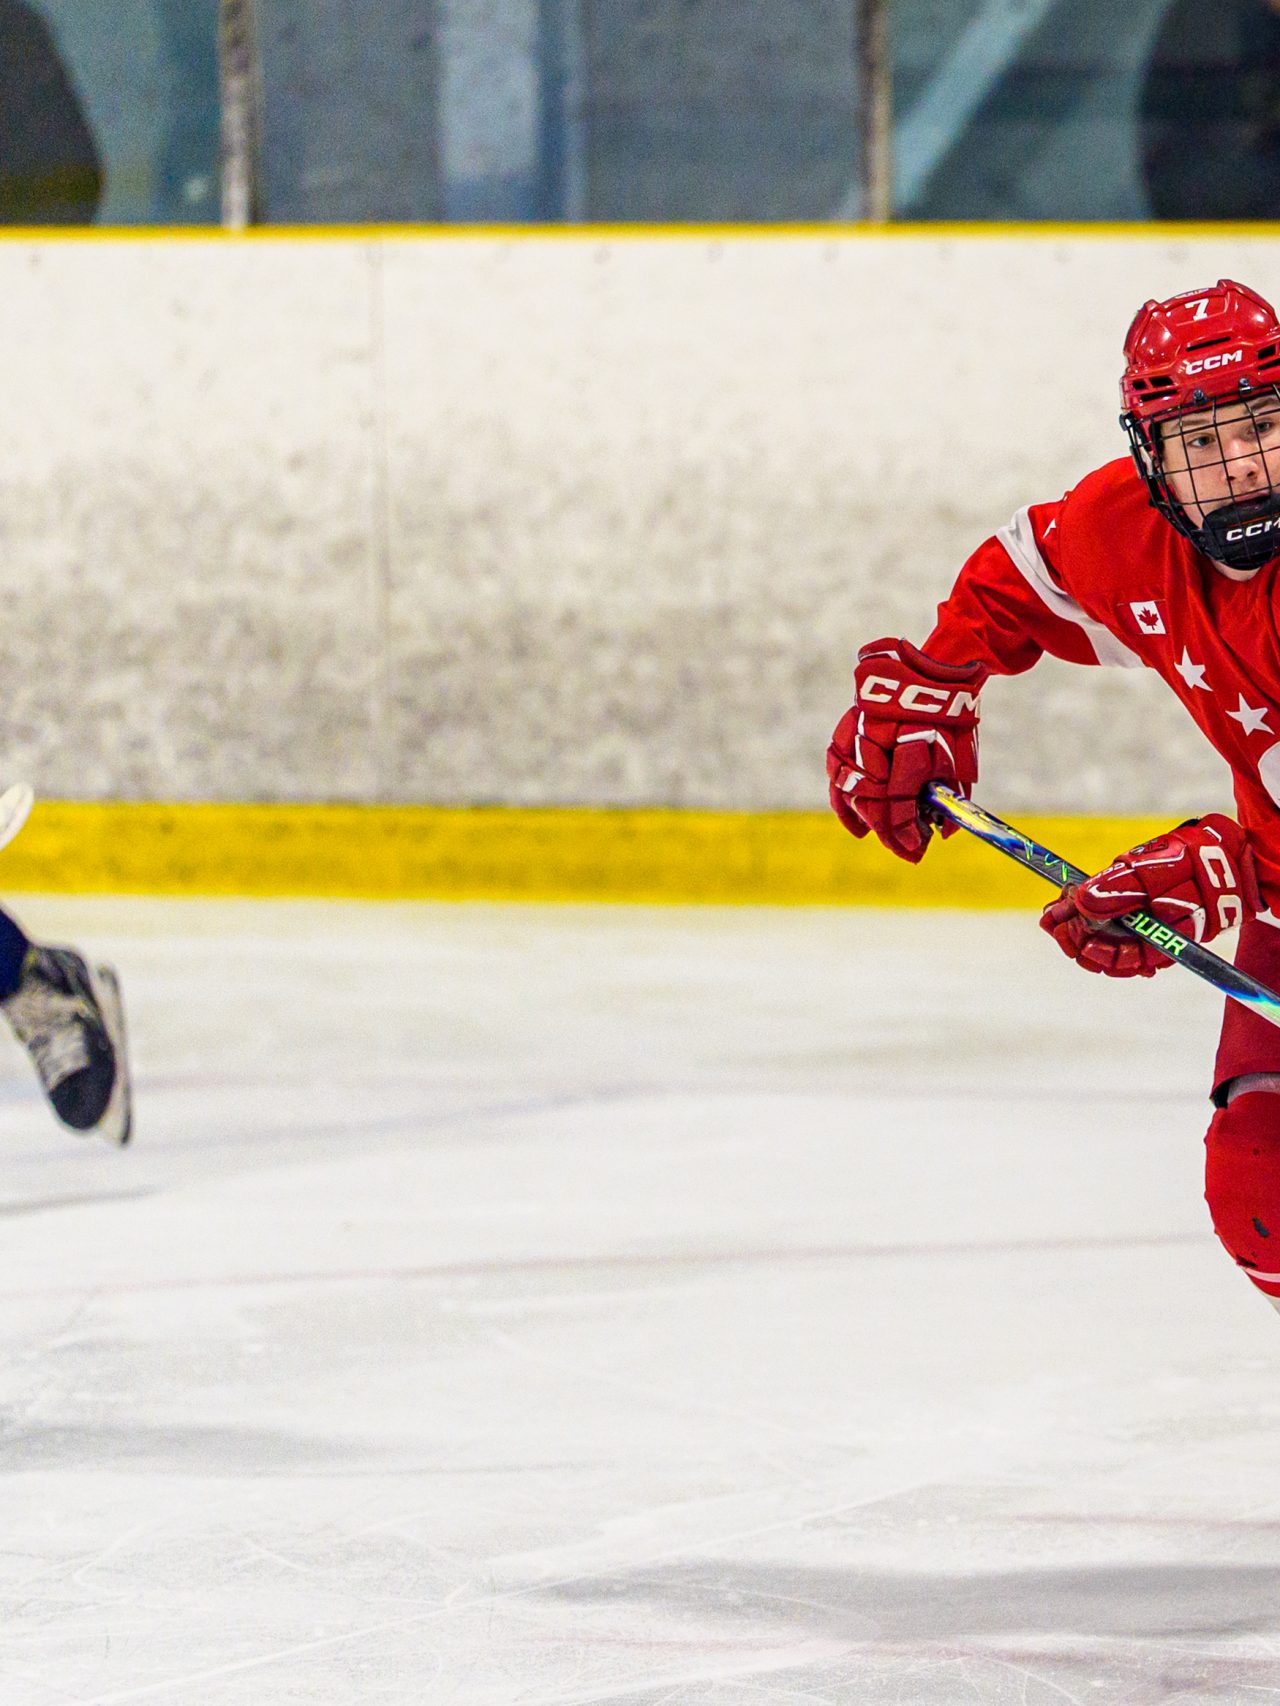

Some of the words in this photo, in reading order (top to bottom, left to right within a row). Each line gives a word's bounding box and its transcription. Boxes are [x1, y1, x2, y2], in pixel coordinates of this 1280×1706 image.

[1185, 298, 1209, 321] 7
[1185, 349, 1243, 376] CCM
[860, 674, 981, 719] CCM
